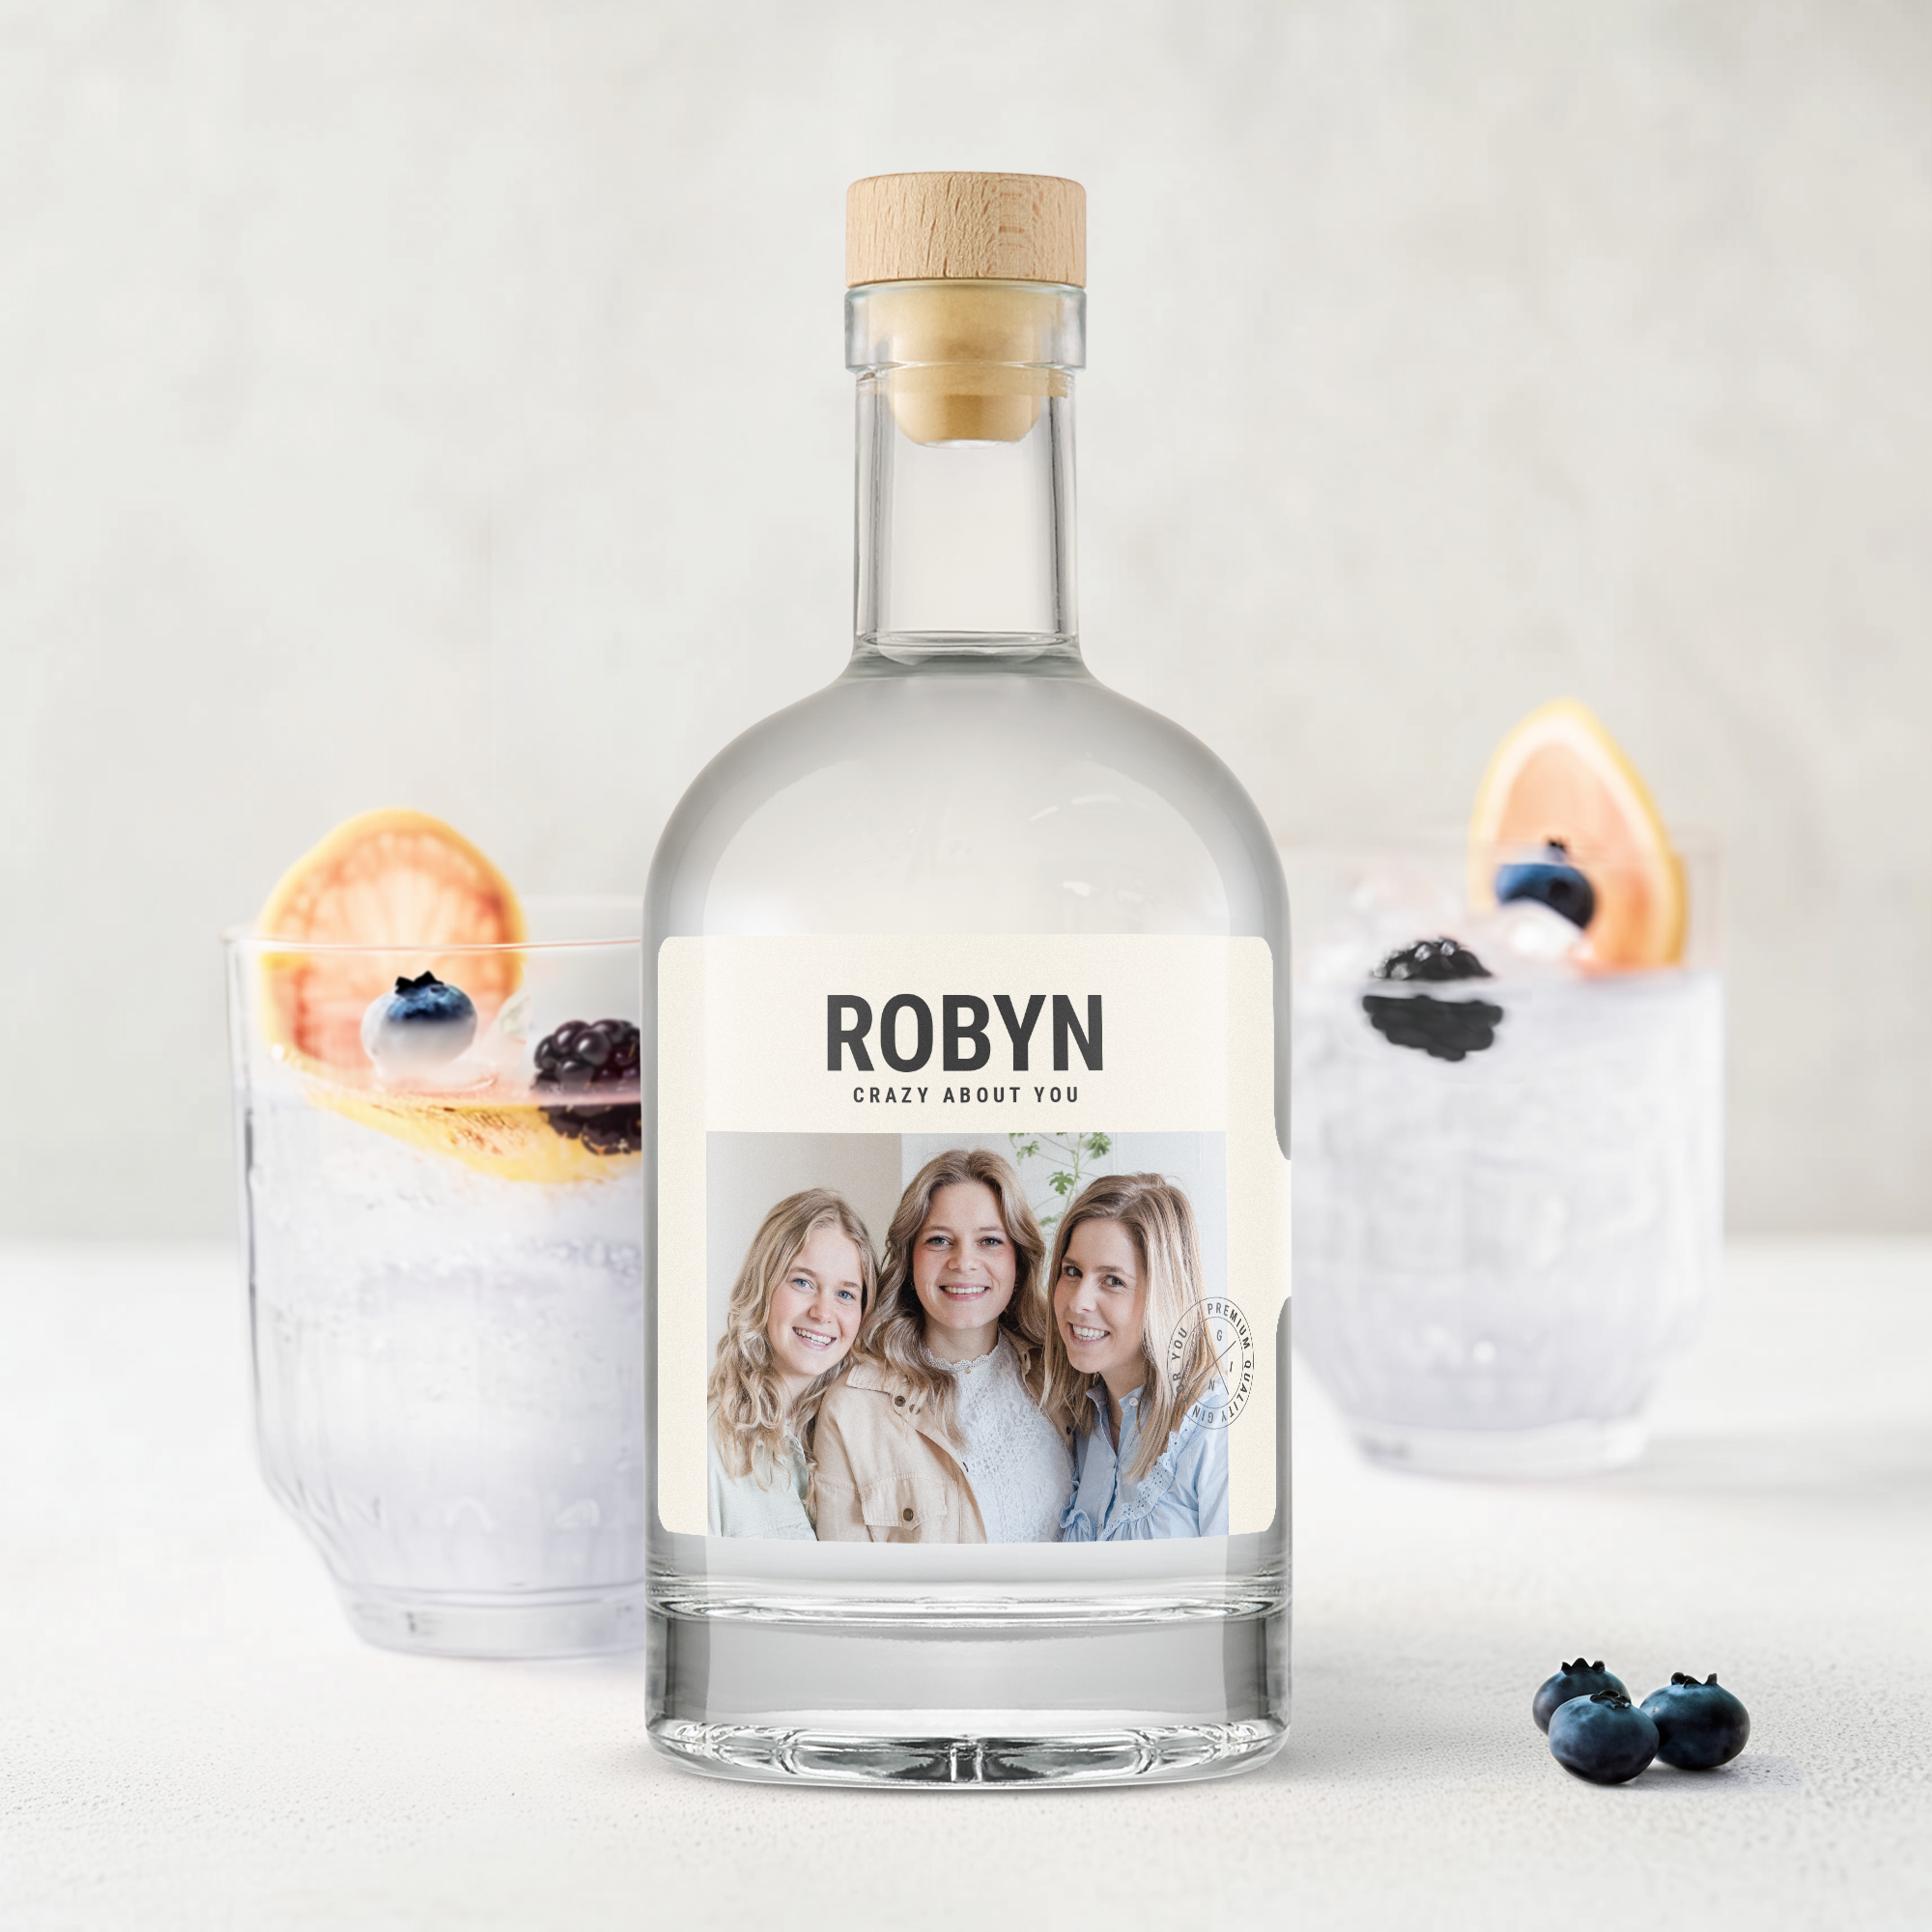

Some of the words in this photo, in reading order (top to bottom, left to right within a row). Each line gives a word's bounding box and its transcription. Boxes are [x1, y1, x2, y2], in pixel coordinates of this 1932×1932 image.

[827, 993, 1103, 1072] ROBYN
[853, 1087, 928, 1103] CRAZY
[943, 1087, 1020, 1103] ABOUT
[1034, 1087, 1078, 1103] YOU
[1171, 1326, 1188, 1361] YOU
[1208, 1302, 1251, 1350] PREMIUM
[1172, 1372, 1190, 1405] FOR
[1221, 1359, 1252, 1423] QUALITY
[1192, 1405, 1214, 1424] GIN
